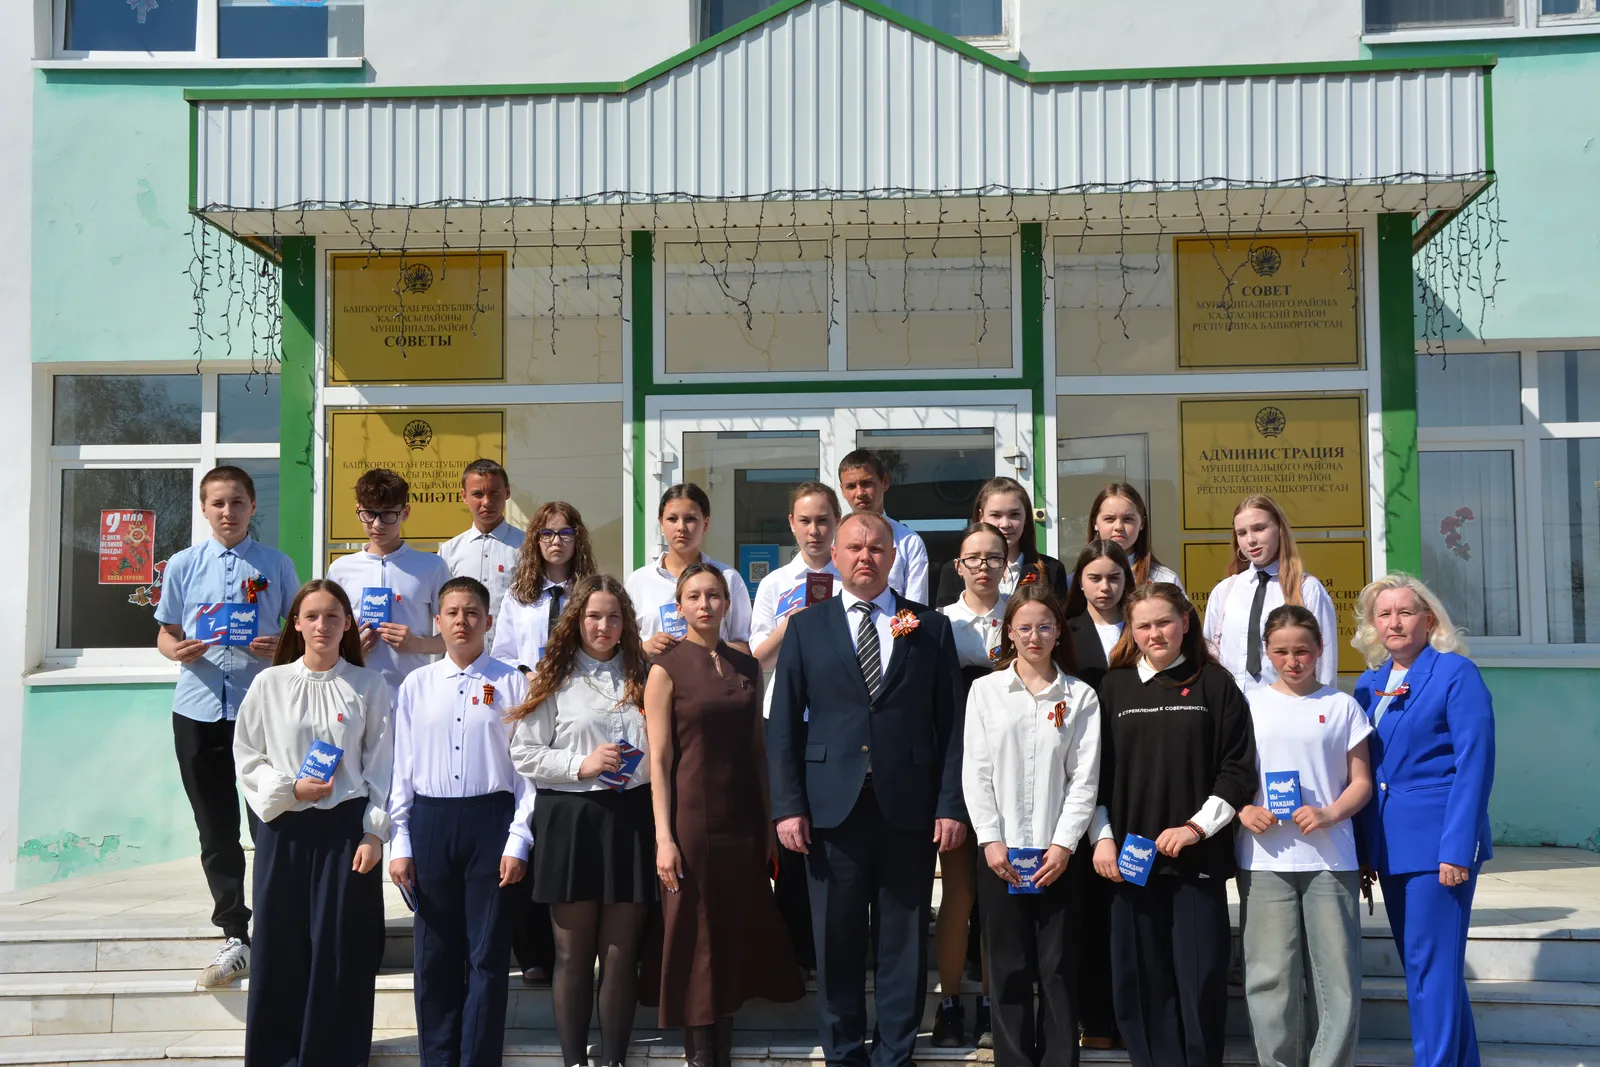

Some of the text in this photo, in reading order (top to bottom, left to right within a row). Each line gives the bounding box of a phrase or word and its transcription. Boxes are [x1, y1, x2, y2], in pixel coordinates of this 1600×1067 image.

[1241, 285, 1291, 297] СОВЕТ
[1297, 298, 1338, 307] РАЙОНА
[424, 313, 462, 322] РАЙОНЫ
[1292, 308, 1326, 318] РАЙОН
[438, 323, 468, 332] РАЙОН
[1260, 320, 1343, 330] БАШКОРТОСТАН
[384, 335, 452, 347] СОВЕТЫ
[1198, 446, 1345, 461] АДМИНИСТРАЦИЯ
[1200, 461, 1344, 473] МУНИЦИПАЛЬНОГО РАЙОНА
[422, 470, 459, 478] РАЙОНЫ
[1213, 472, 1331, 483] КАЛТАСИНСКИЙ РАЙОН
[431, 480, 462, 489] РАЙОН
[1196, 484, 1349, 495] РЕСПУБЛИКИ БАШКОРТОСТАН
[106, 512, 143, 533] 9 МАЯ
[1122, 707, 1159, 716] СТРЕМЛЕНИИ
[303, 765, 326, 779] ГРАЖДАНЕ
[1120, 860, 1144, 873] ГРАЖДАНЕ
